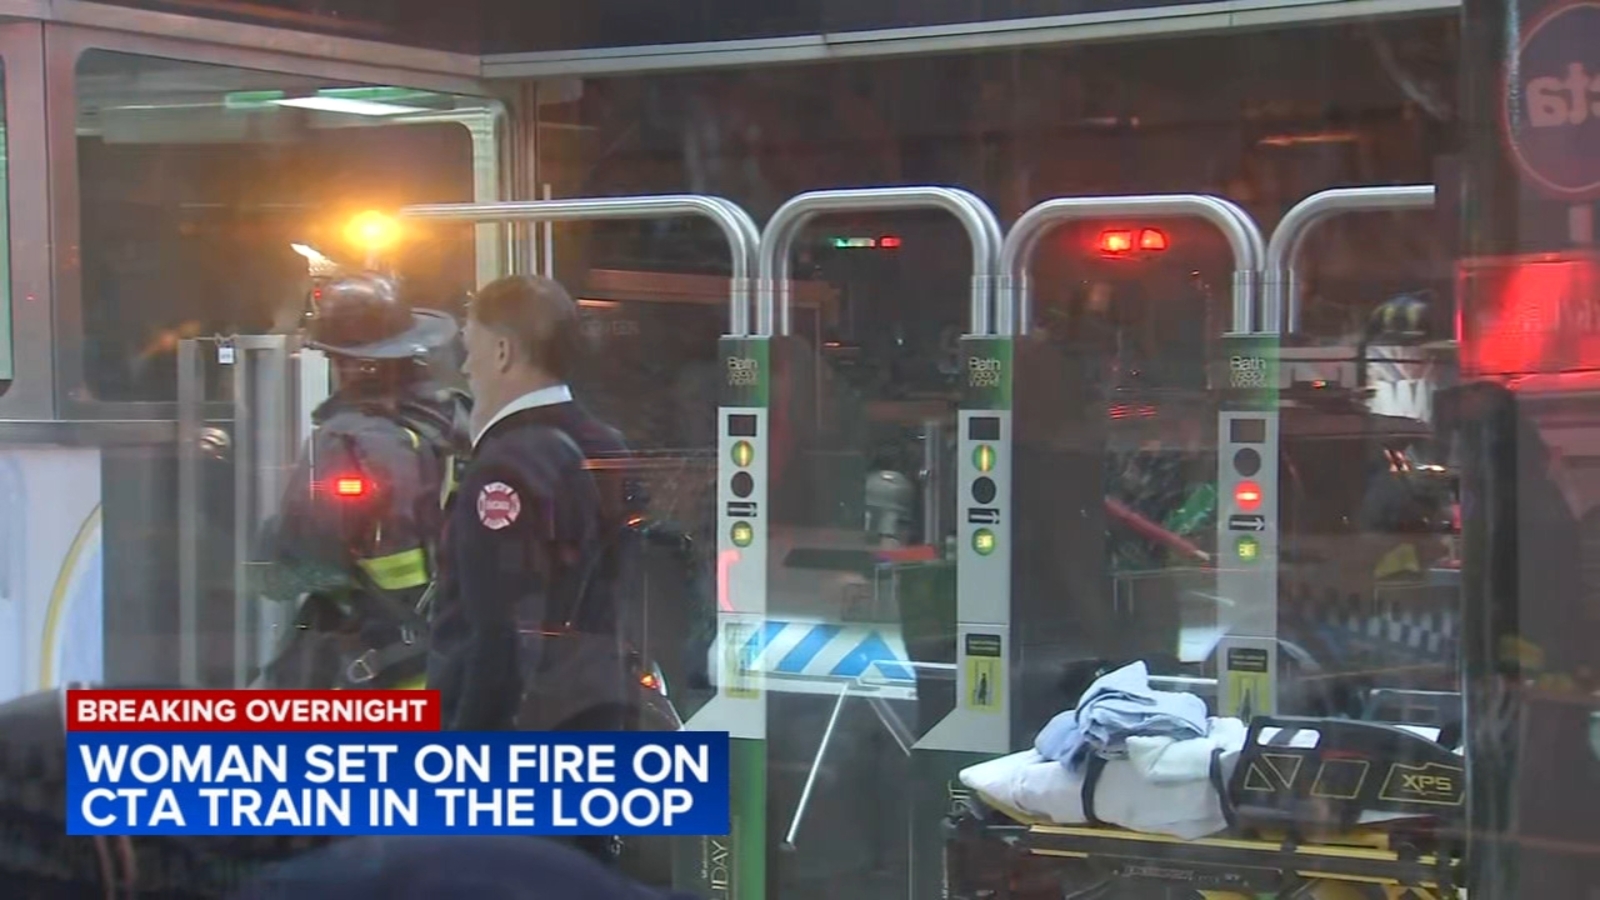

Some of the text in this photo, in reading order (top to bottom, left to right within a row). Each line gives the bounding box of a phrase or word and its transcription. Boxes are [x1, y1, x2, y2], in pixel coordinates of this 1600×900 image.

[969, 356, 1001, 370] Bath
[1230, 355, 1266, 370] Bath
[1402, 774, 1452, 791] XPS
